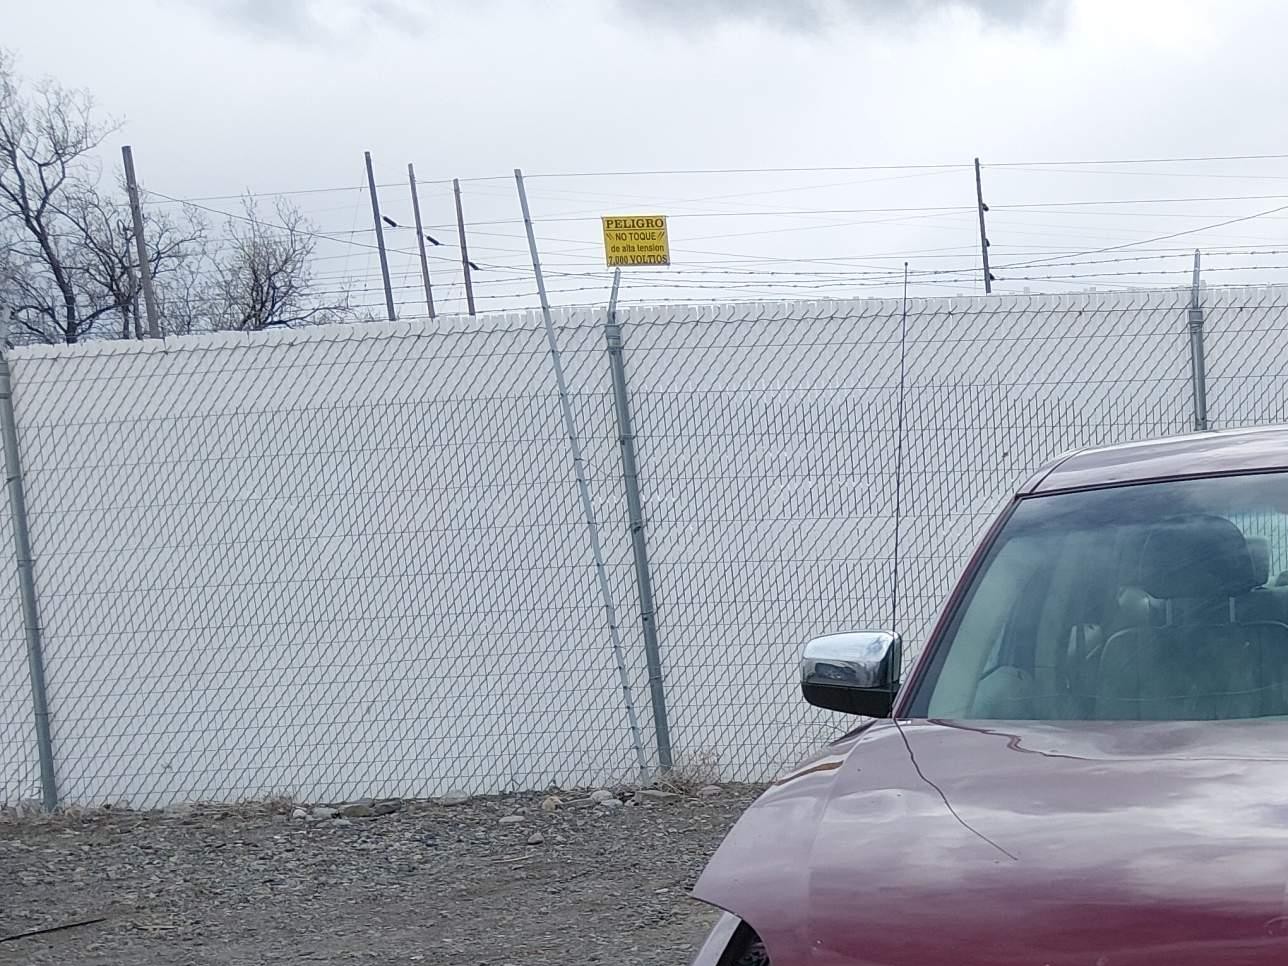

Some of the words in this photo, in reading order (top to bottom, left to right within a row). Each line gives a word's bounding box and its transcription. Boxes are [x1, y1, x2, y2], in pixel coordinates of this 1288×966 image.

[606, 219, 664, 228] PELIGRO
[615, 232, 627, 241] NO
[629, 231, 656, 241] TOQUE
[611, 245, 620, 253] de
[622, 244, 636, 253] alta
[630, 254, 667, 265] VOLTIOS
